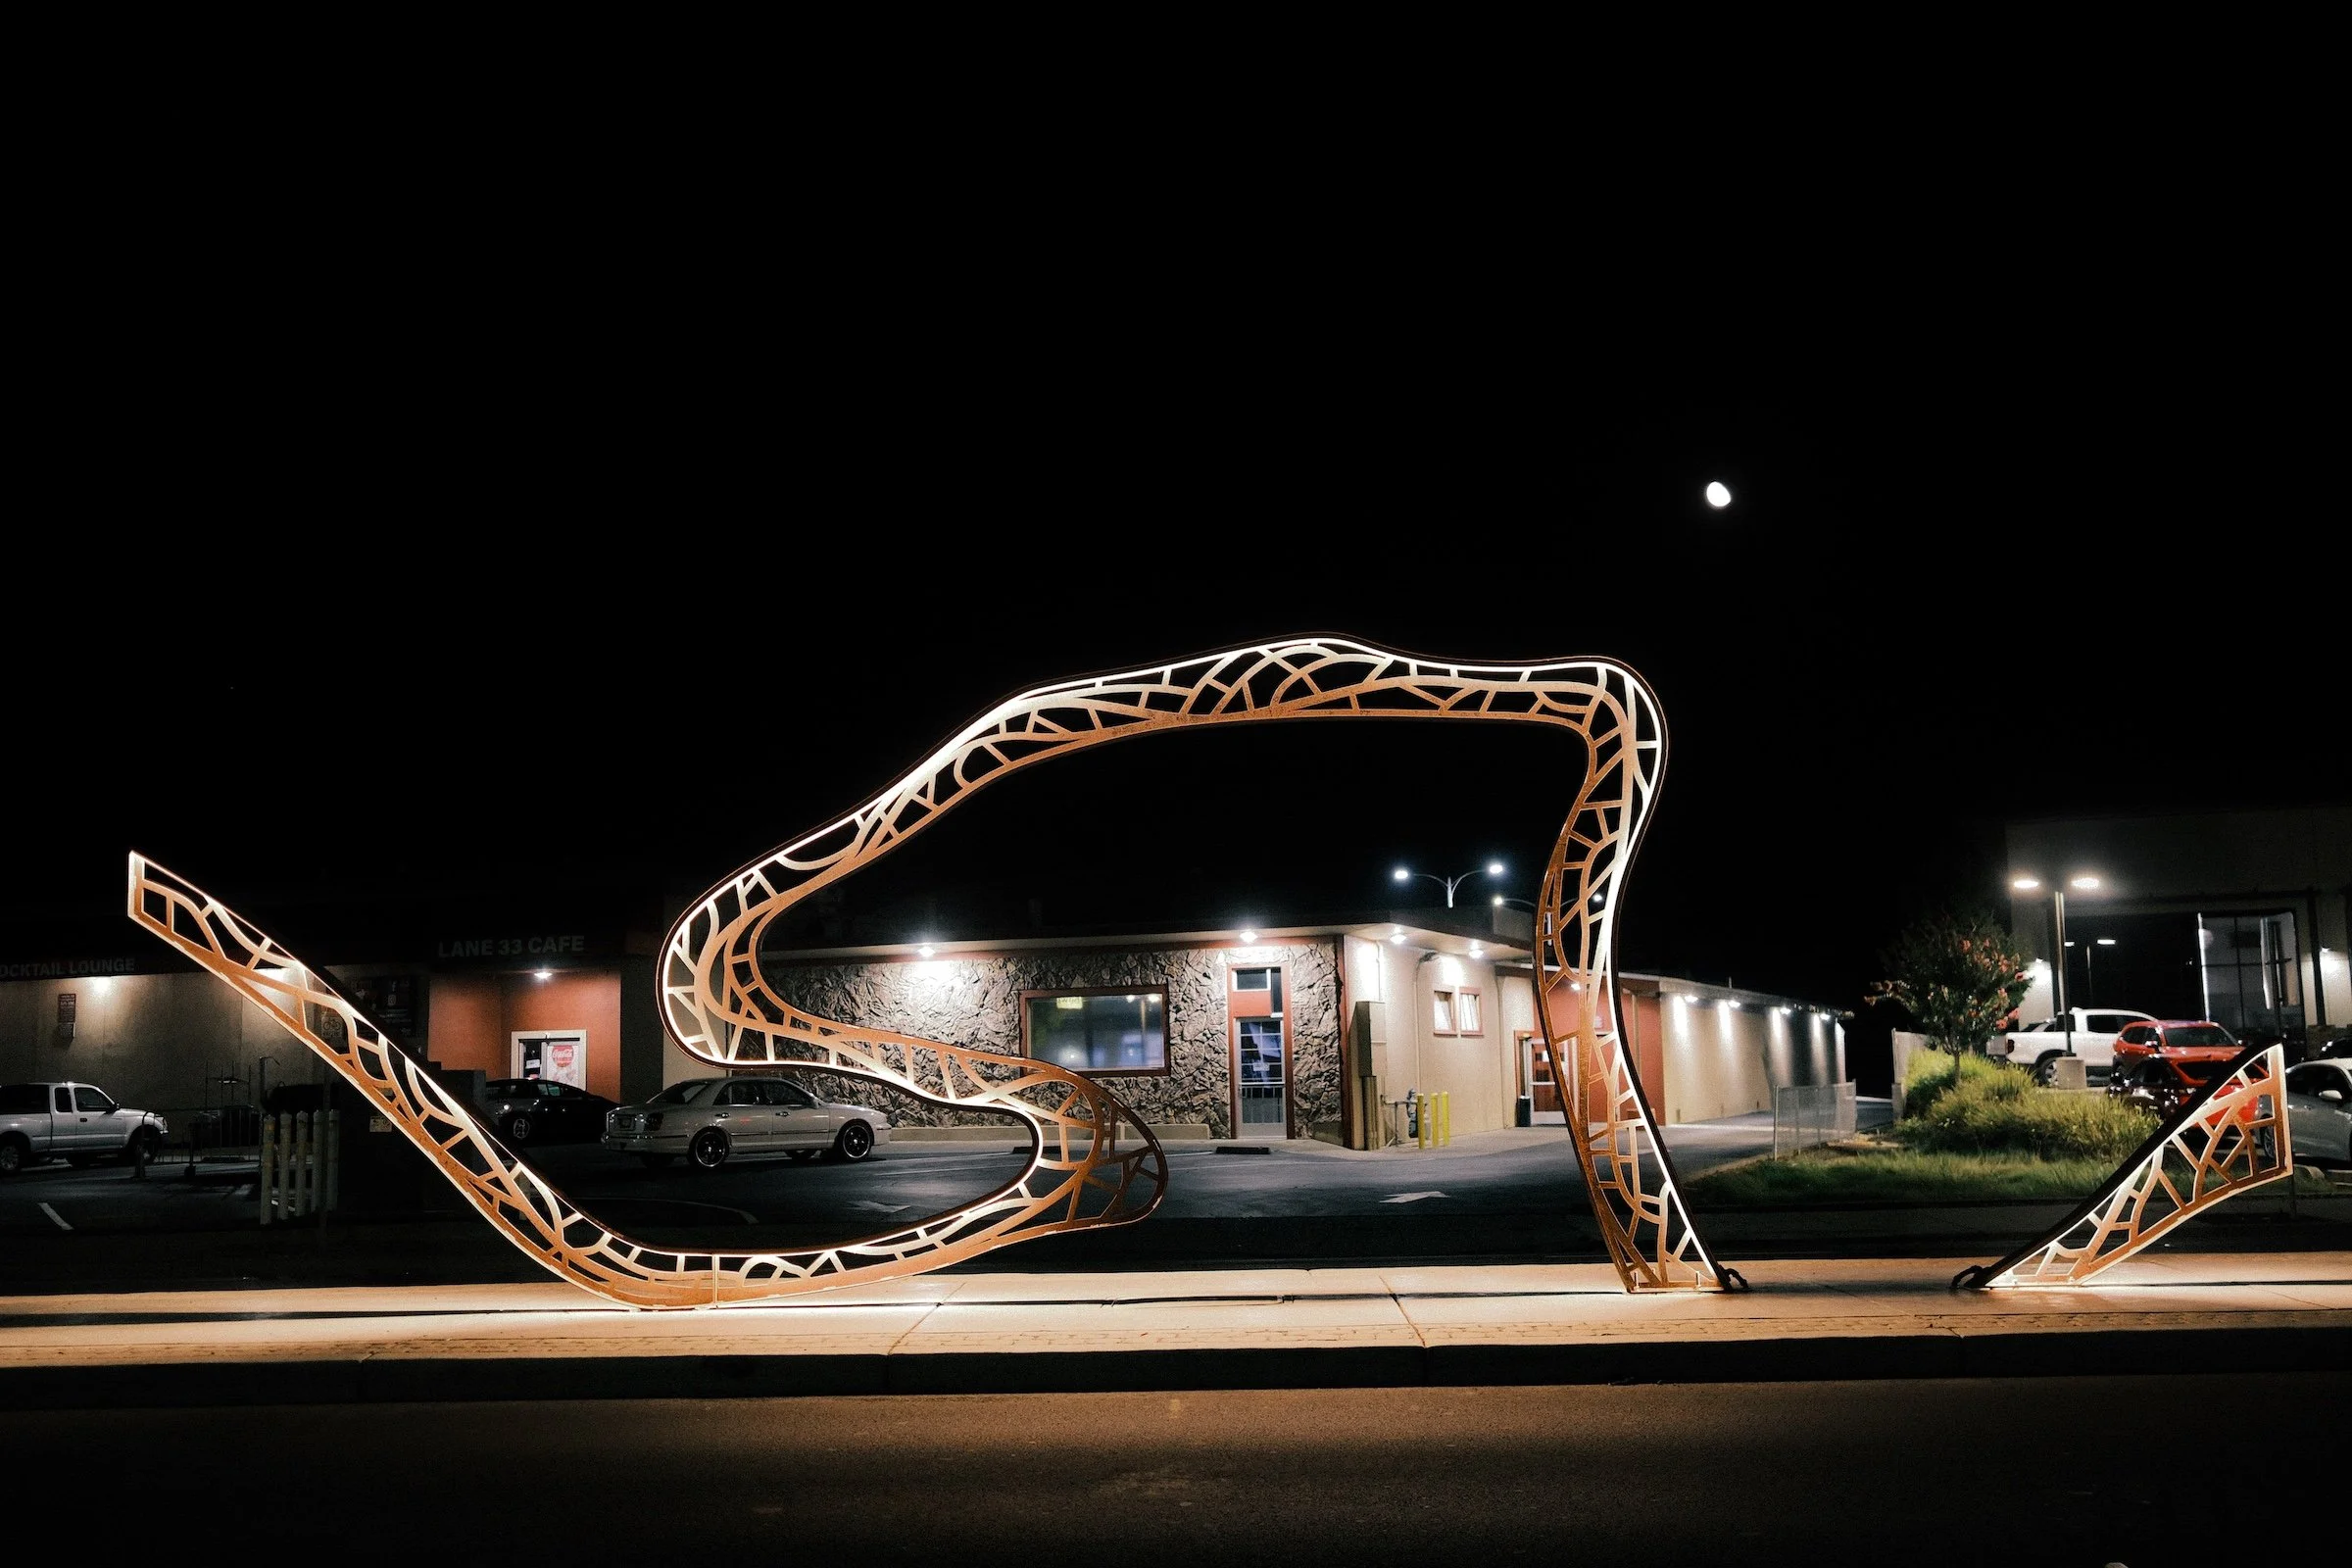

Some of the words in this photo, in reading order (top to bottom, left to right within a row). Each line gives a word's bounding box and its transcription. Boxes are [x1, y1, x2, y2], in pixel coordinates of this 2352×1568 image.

[437, 939, 493, 958] LANE
[497, 938, 523, 956] 33
[528, 934, 586, 954] CAFE
[70, 957, 135, 974] LOUNGE
